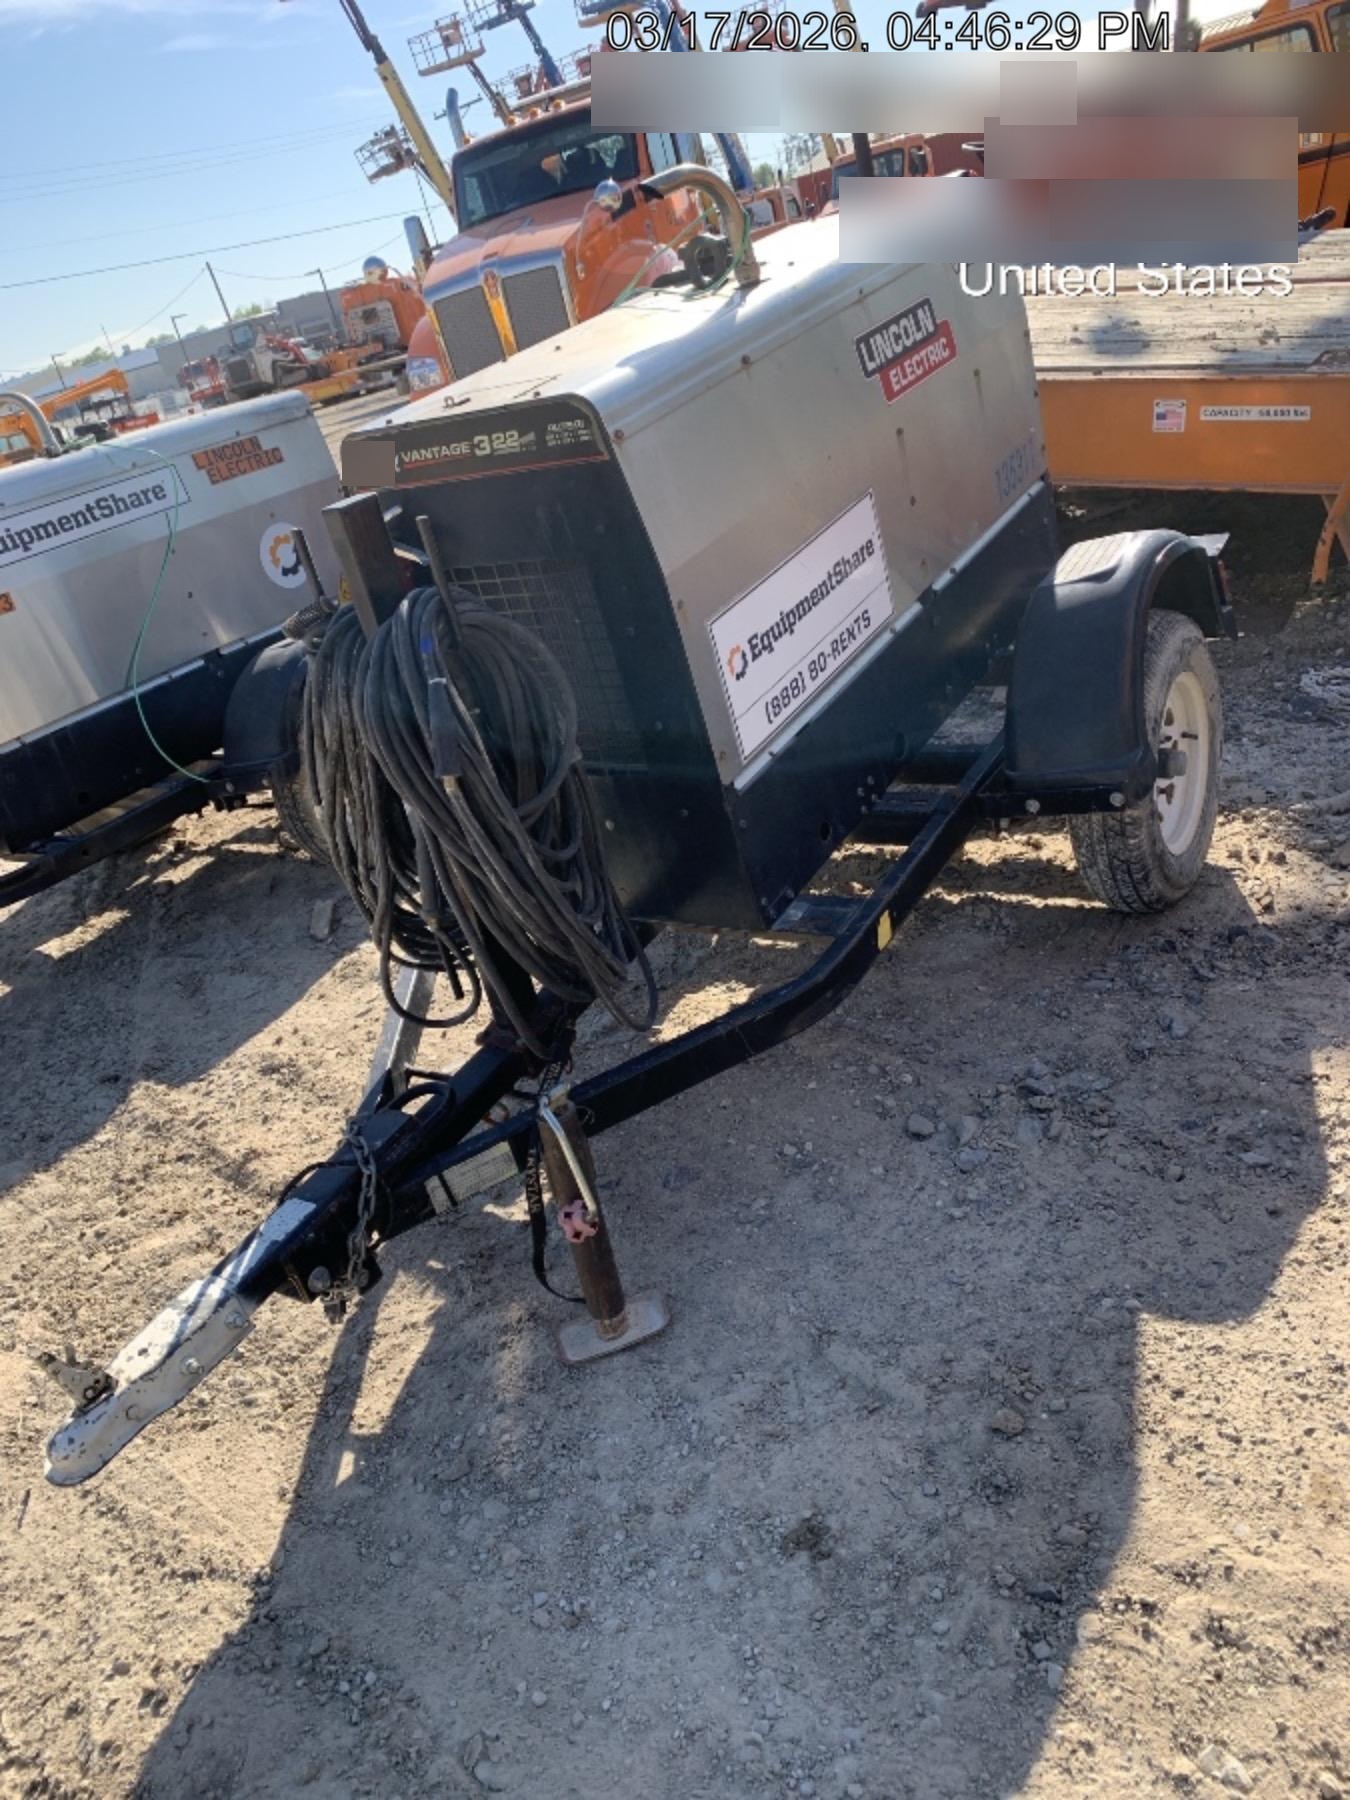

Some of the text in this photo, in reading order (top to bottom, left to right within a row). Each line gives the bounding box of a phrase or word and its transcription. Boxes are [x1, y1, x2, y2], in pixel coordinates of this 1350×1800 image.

[859, 303, 936, 371] LINCOLN
[888, 336, 951, 393] ELECTRIC
[192, 436, 263, 470] LINCOLN
[206, 447, 285, 485] ELECTRIC
[400, 441, 472, 464] VANTAGE
[473, 430, 520, 457] 322
[747, 538, 876, 662] EquipmentShare
[764, 608, 872, 725] (888) 80-RENTS
